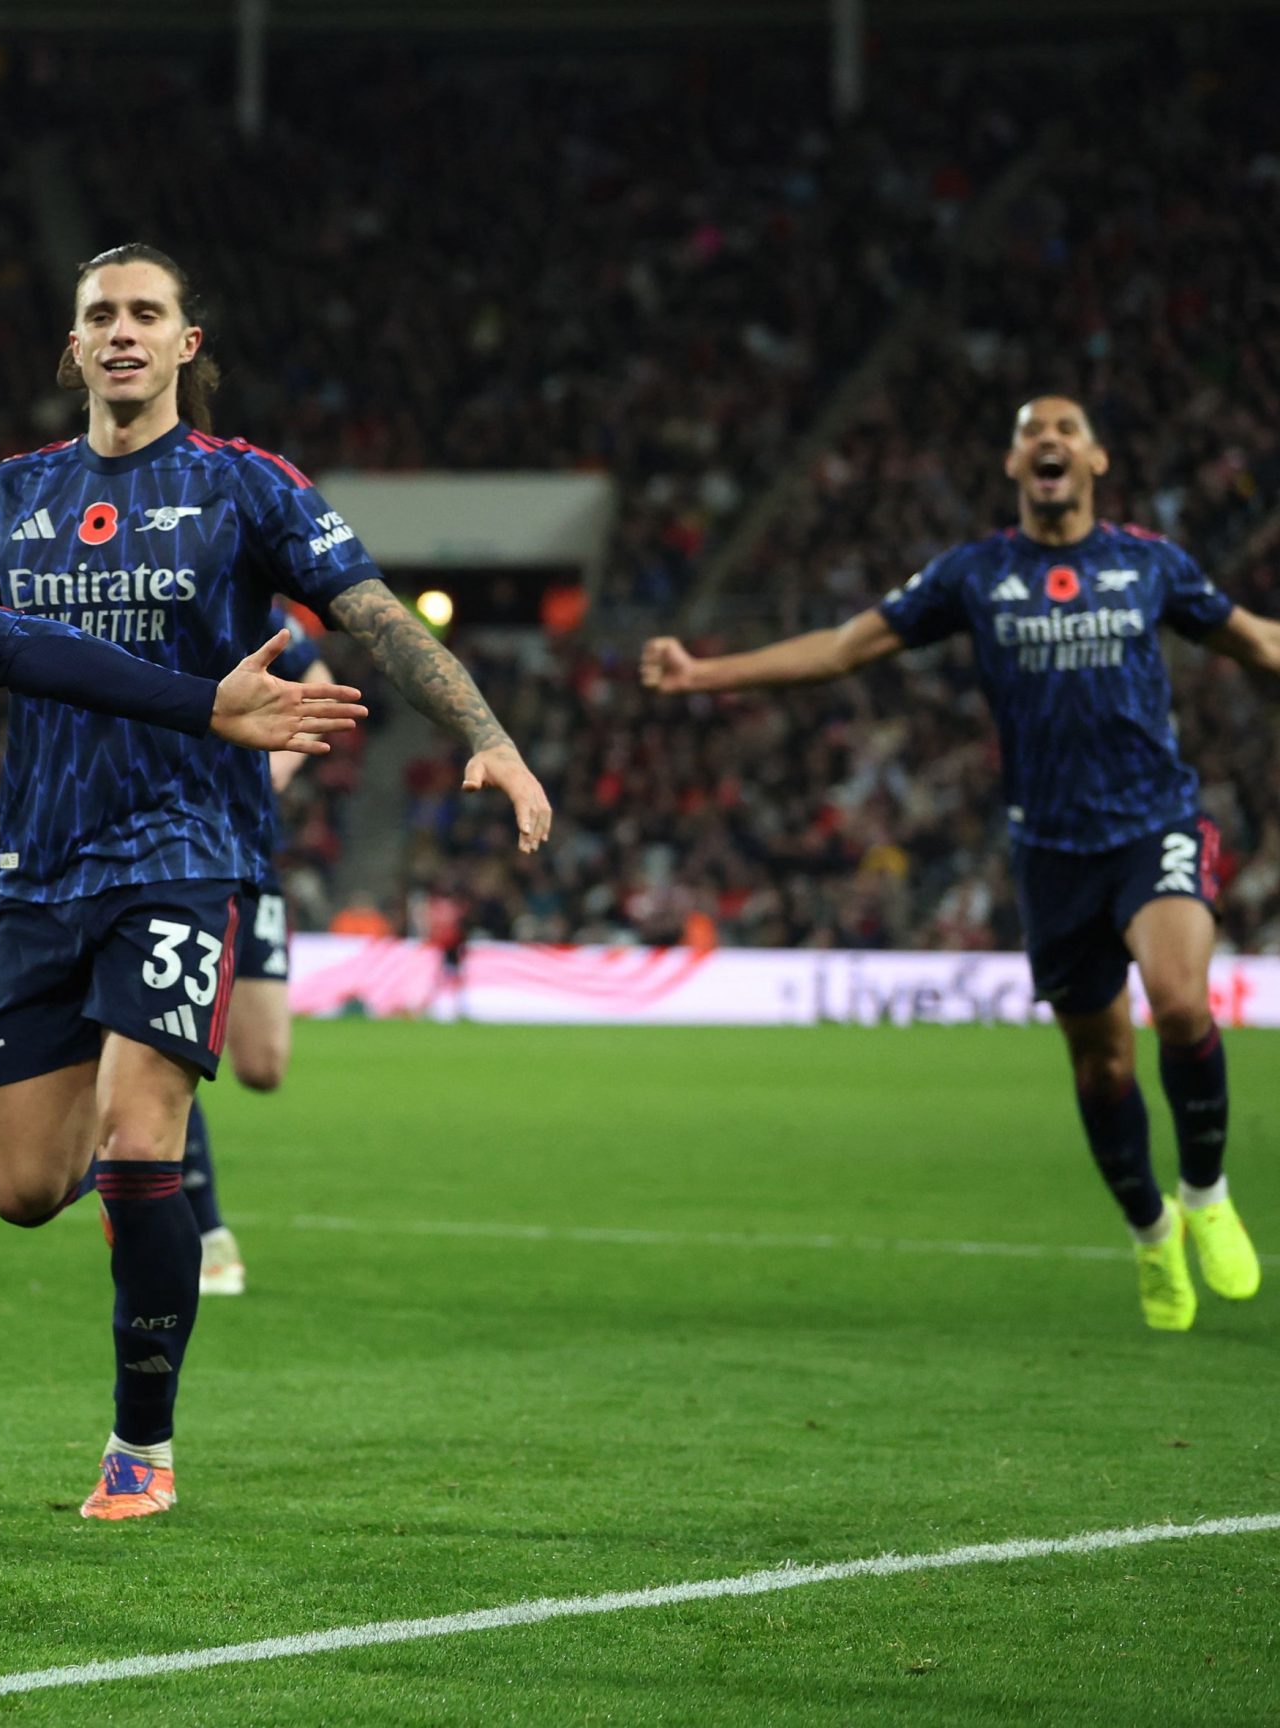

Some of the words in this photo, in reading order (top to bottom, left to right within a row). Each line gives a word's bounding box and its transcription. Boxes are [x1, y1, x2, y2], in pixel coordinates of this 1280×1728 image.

[8, 562, 197, 609] Emirates
[81, 609, 166, 642] BETTER
[994, 607, 1145, 646] Emirates
[142, 918, 223, 1007] 33
[130, 1315, 179, 1330] AFC
